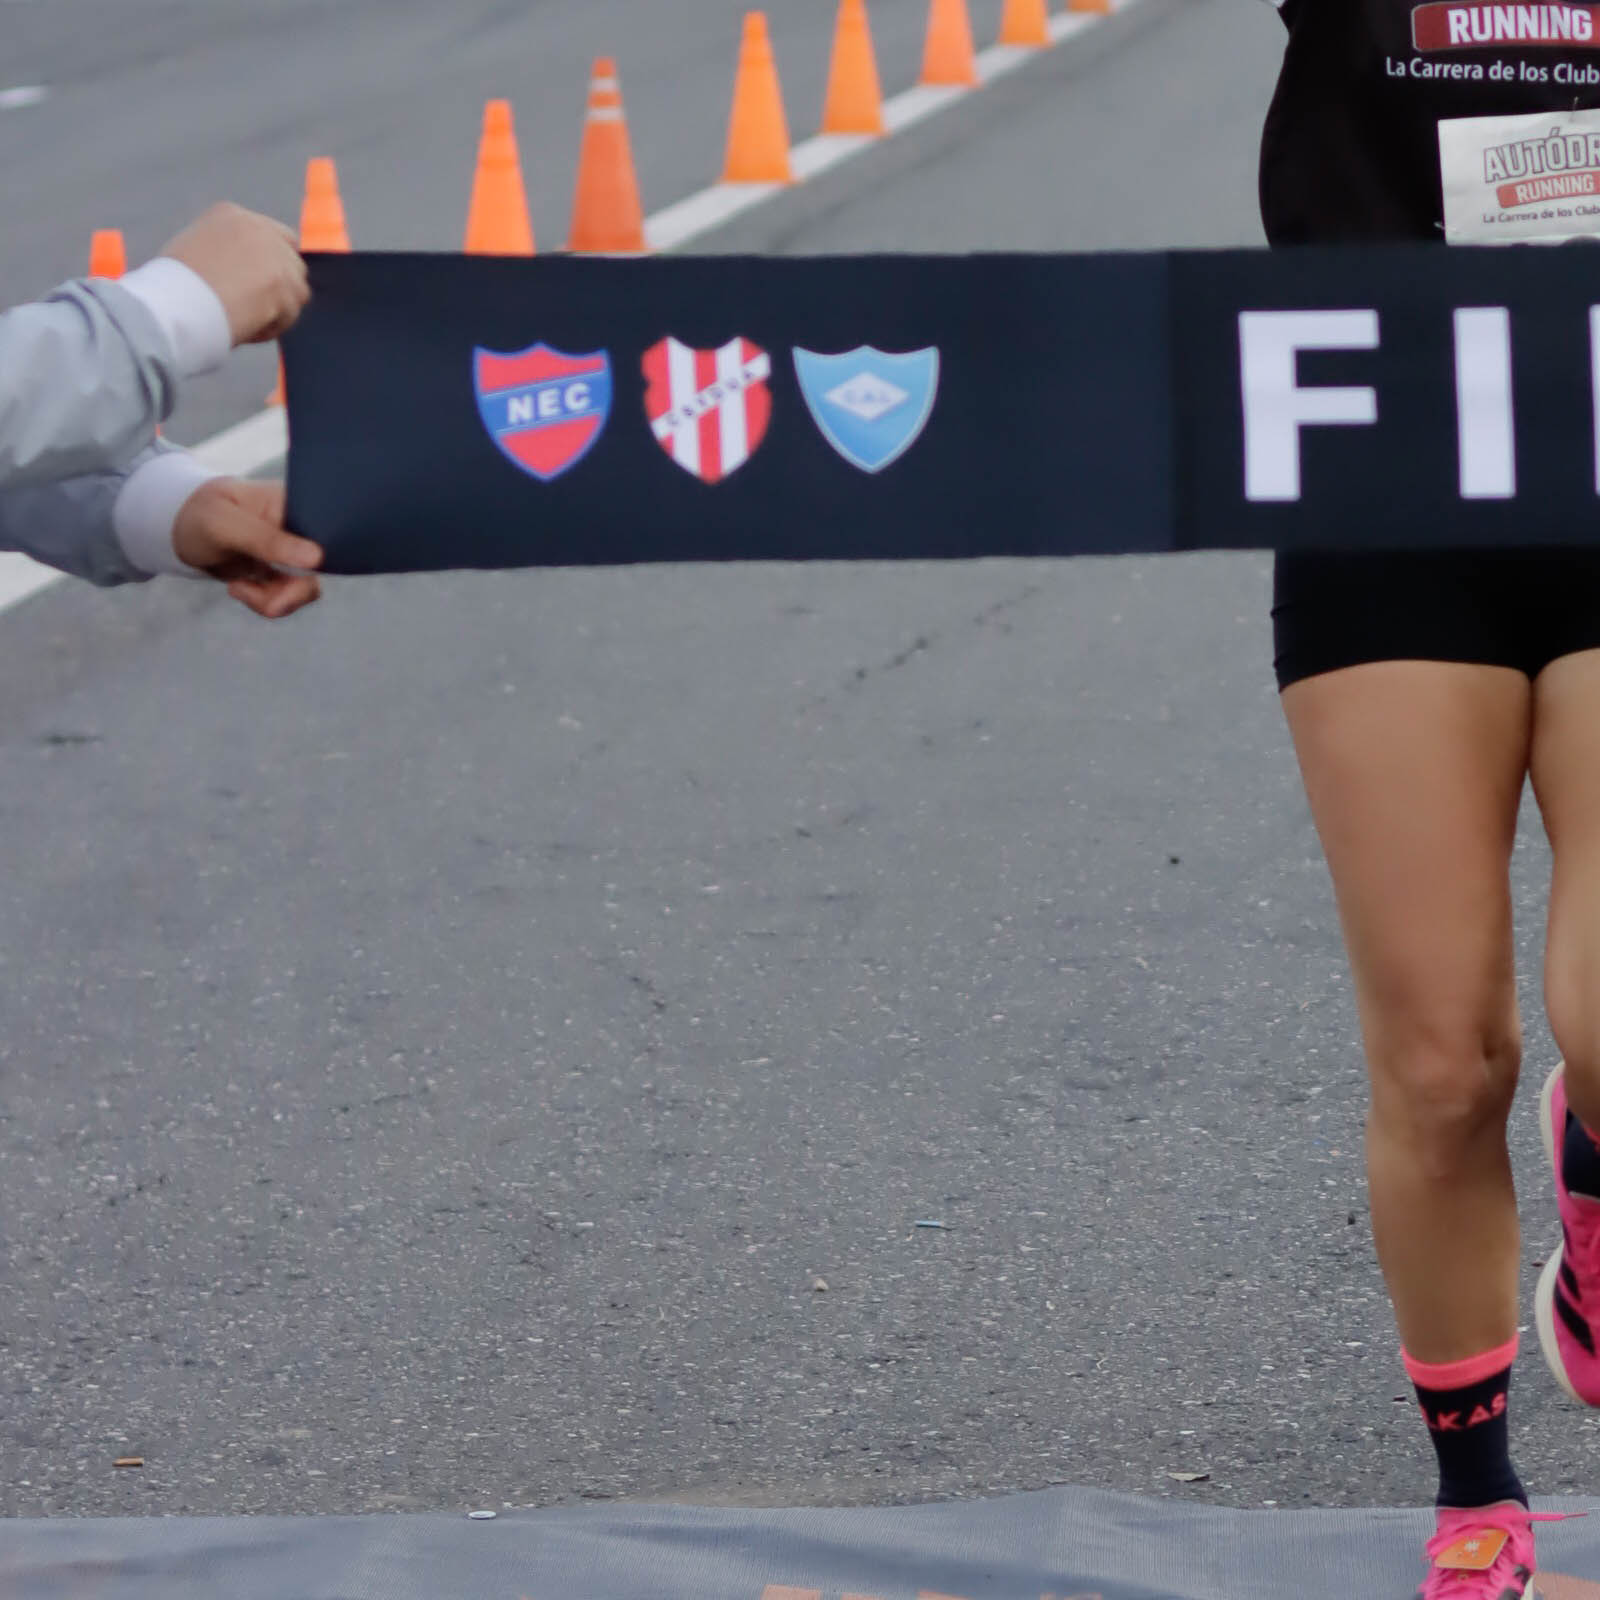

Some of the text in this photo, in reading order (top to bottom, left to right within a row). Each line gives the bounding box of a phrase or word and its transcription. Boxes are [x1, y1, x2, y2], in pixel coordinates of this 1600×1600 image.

[1447, 5, 1592, 45] RUNNING
[1386, 57, 1406, 76] La
[1410, 58, 1483, 80] Carrera
[1489, 60, 1515, 81] de
[1520, 61, 1548, 82] los
[1515, 174, 1594, 203] RUNNING
[1483, 213, 1496, 223] La
[1498, 208, 1537, 223] Carrera
[1541, 207, 1554, 219] de
[1557, 206, 1573, 218] los
[507, 382, 592, 425] NEC
